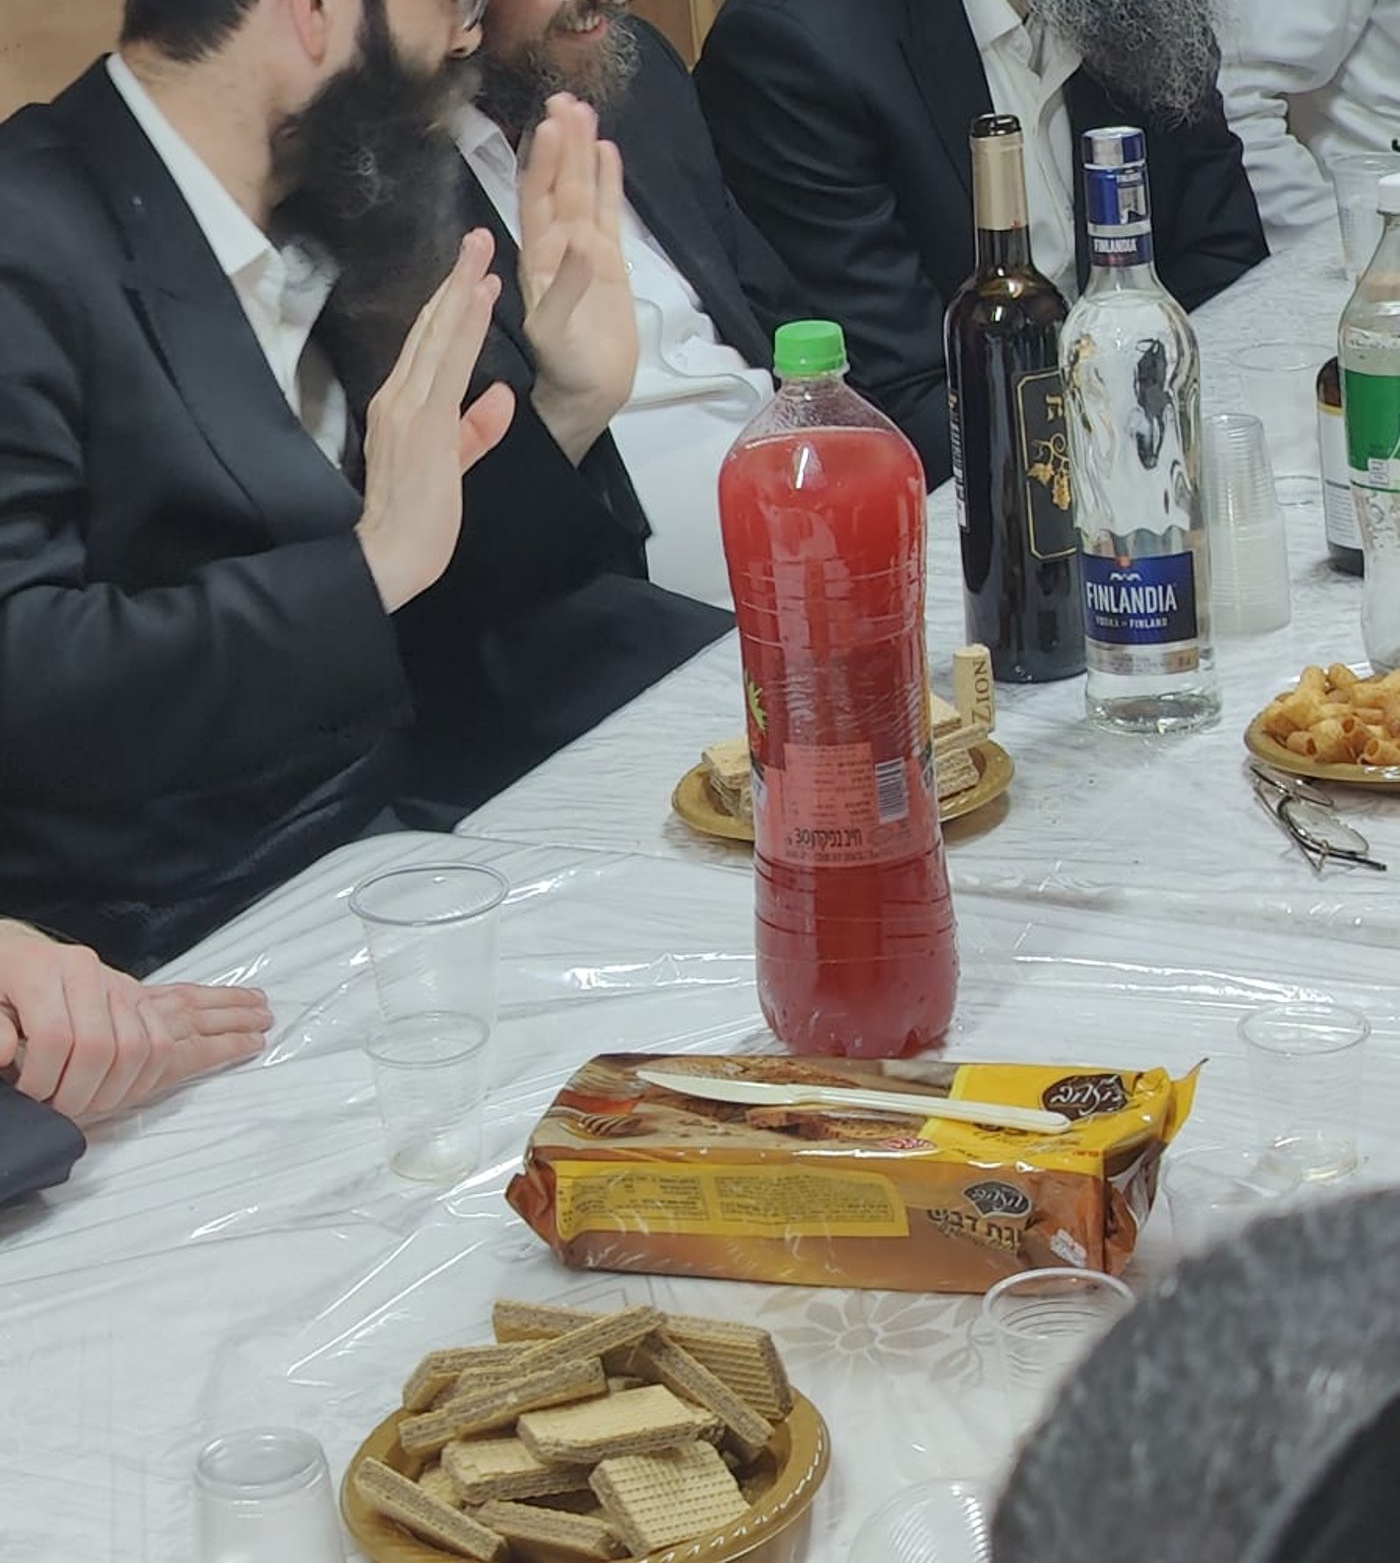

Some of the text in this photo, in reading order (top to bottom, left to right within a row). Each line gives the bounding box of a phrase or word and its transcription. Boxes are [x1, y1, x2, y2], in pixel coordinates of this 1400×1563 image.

[1085, 581, 1178, 614] FINLANDIA
[971, 659, 992, 725] ZION
[927, 1208, 978, 1232] דבש
